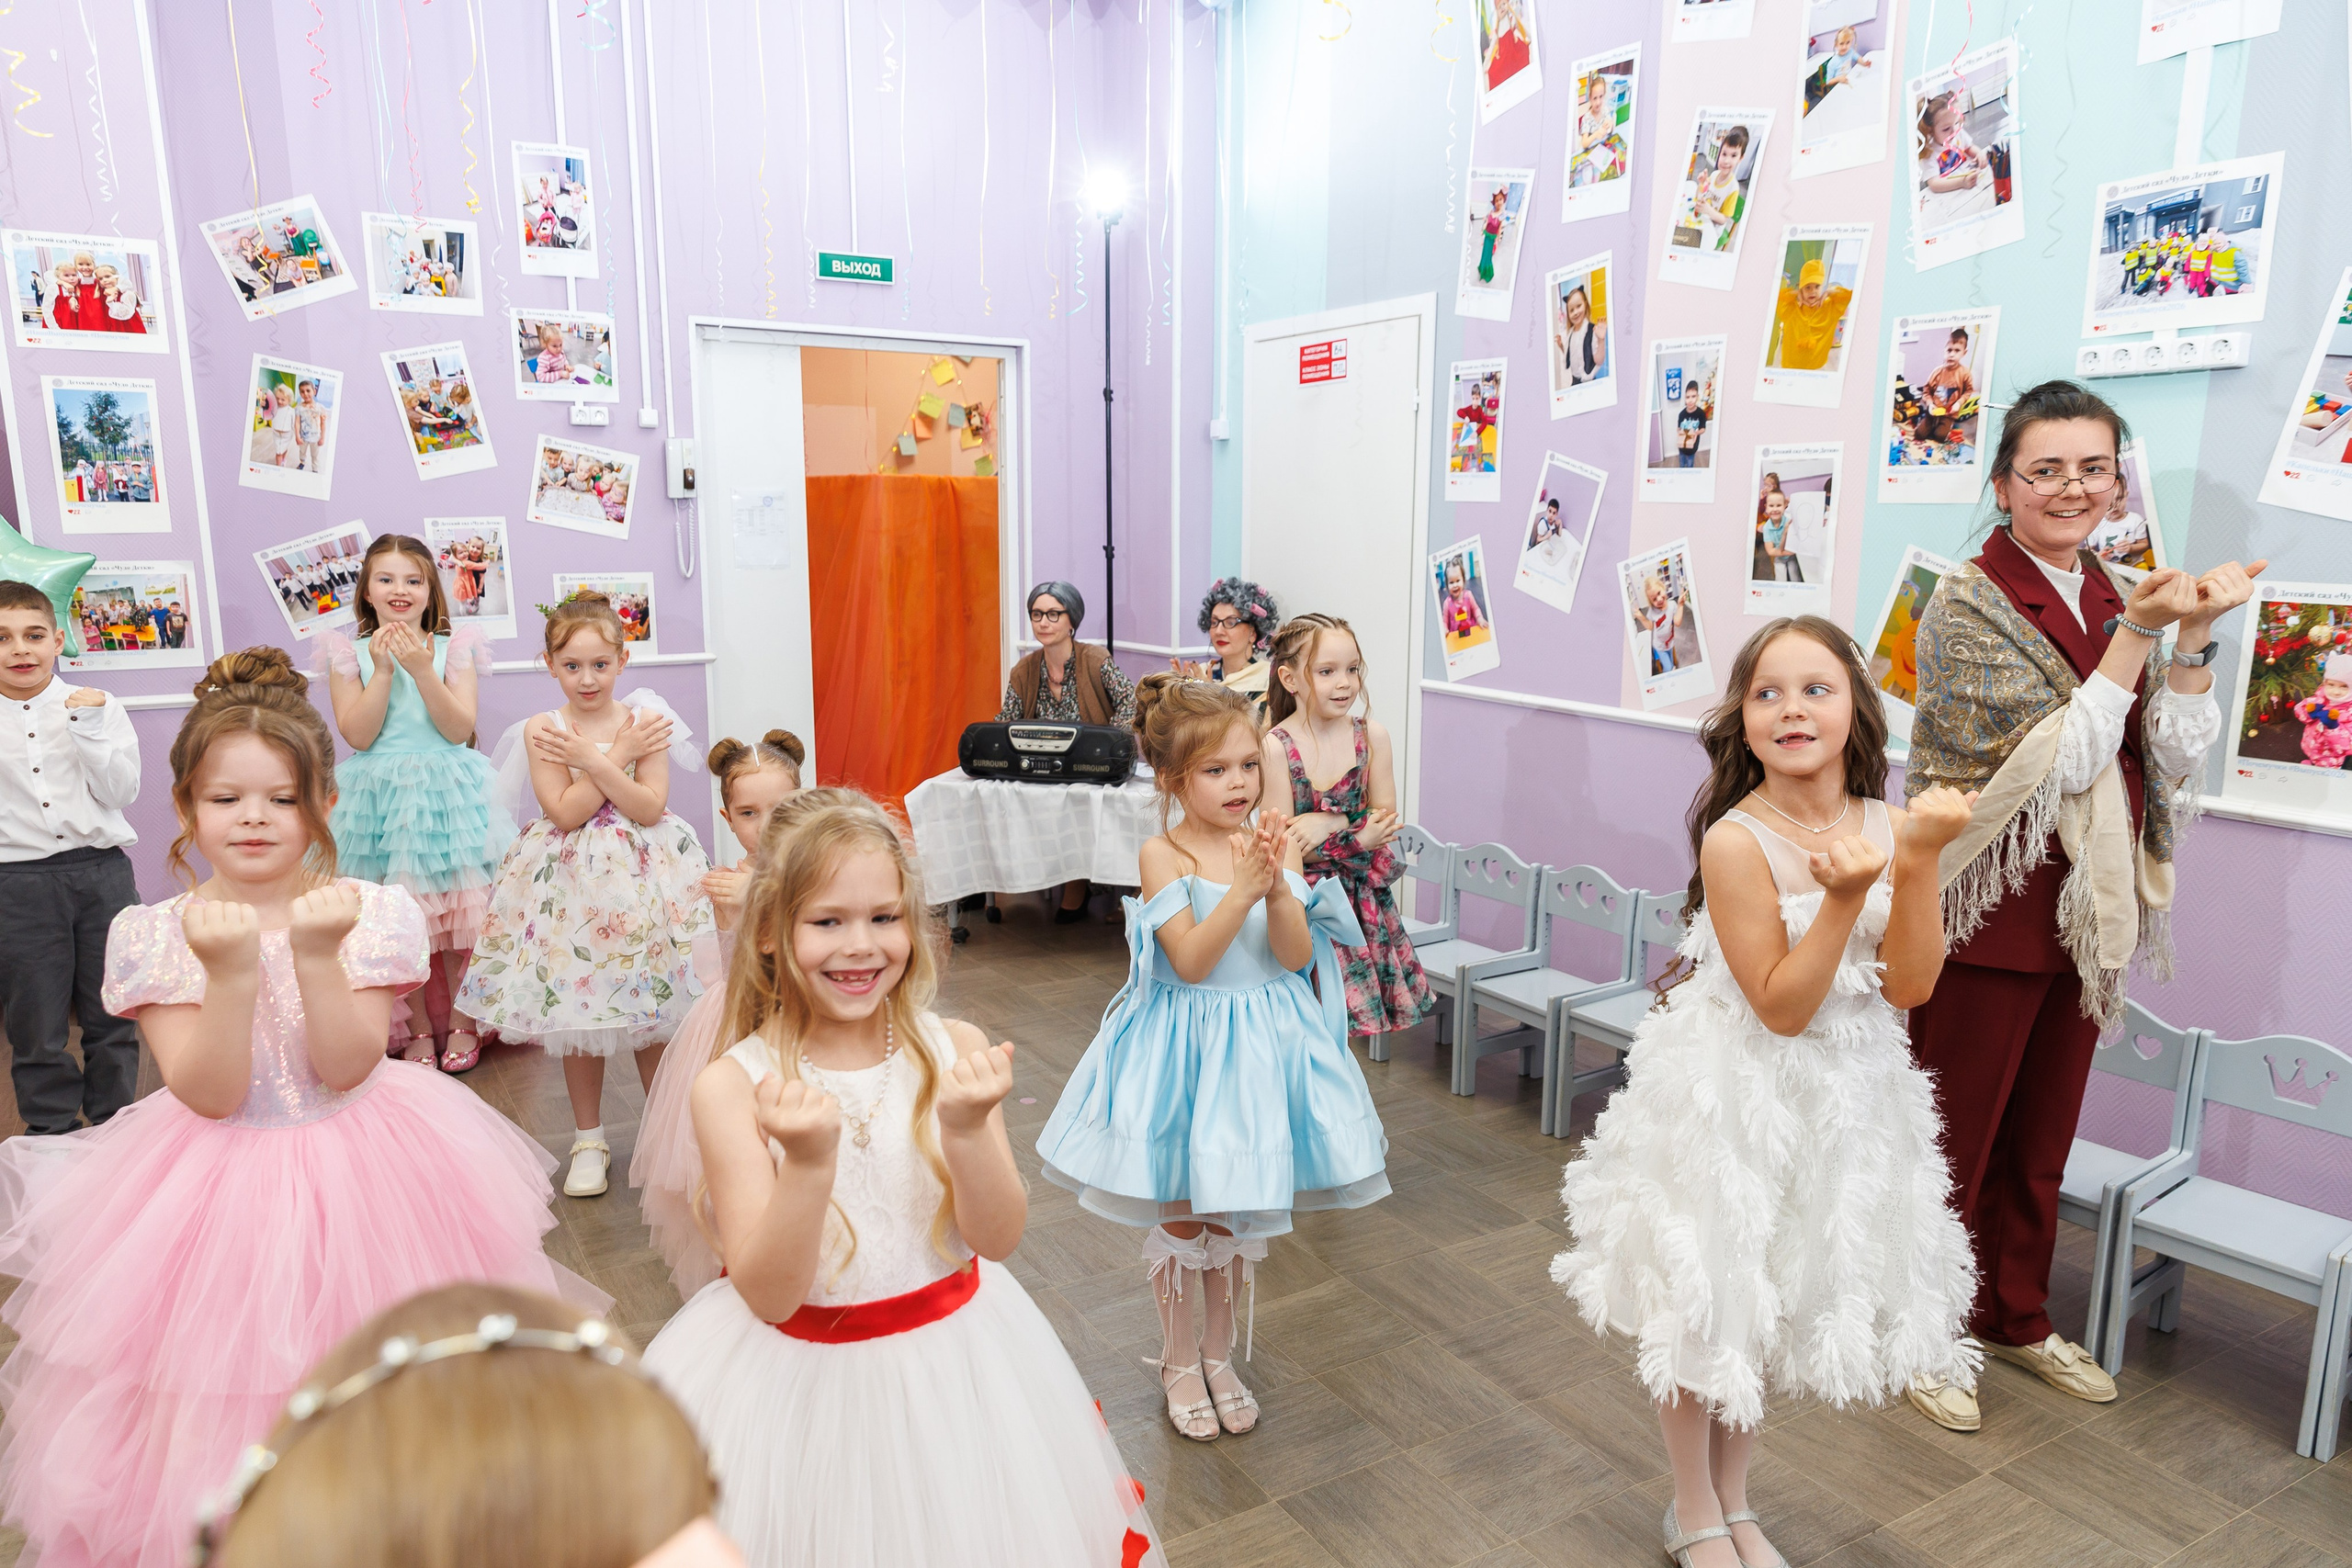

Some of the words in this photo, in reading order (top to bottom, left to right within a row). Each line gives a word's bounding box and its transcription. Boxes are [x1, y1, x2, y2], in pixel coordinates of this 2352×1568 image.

[2120, 181, 2150, 193] Детский
[2165, 173, 2189, 186] «Чудо
[2189, 169, 2222, 180] Детки»
[831, 260, 881, 278] ВЫХОД
[2278, 590, 2314, 598] Детский
[973, 759, 1009, 768] SURROUND
[1073, 763, 1110, 773] SURROUND
